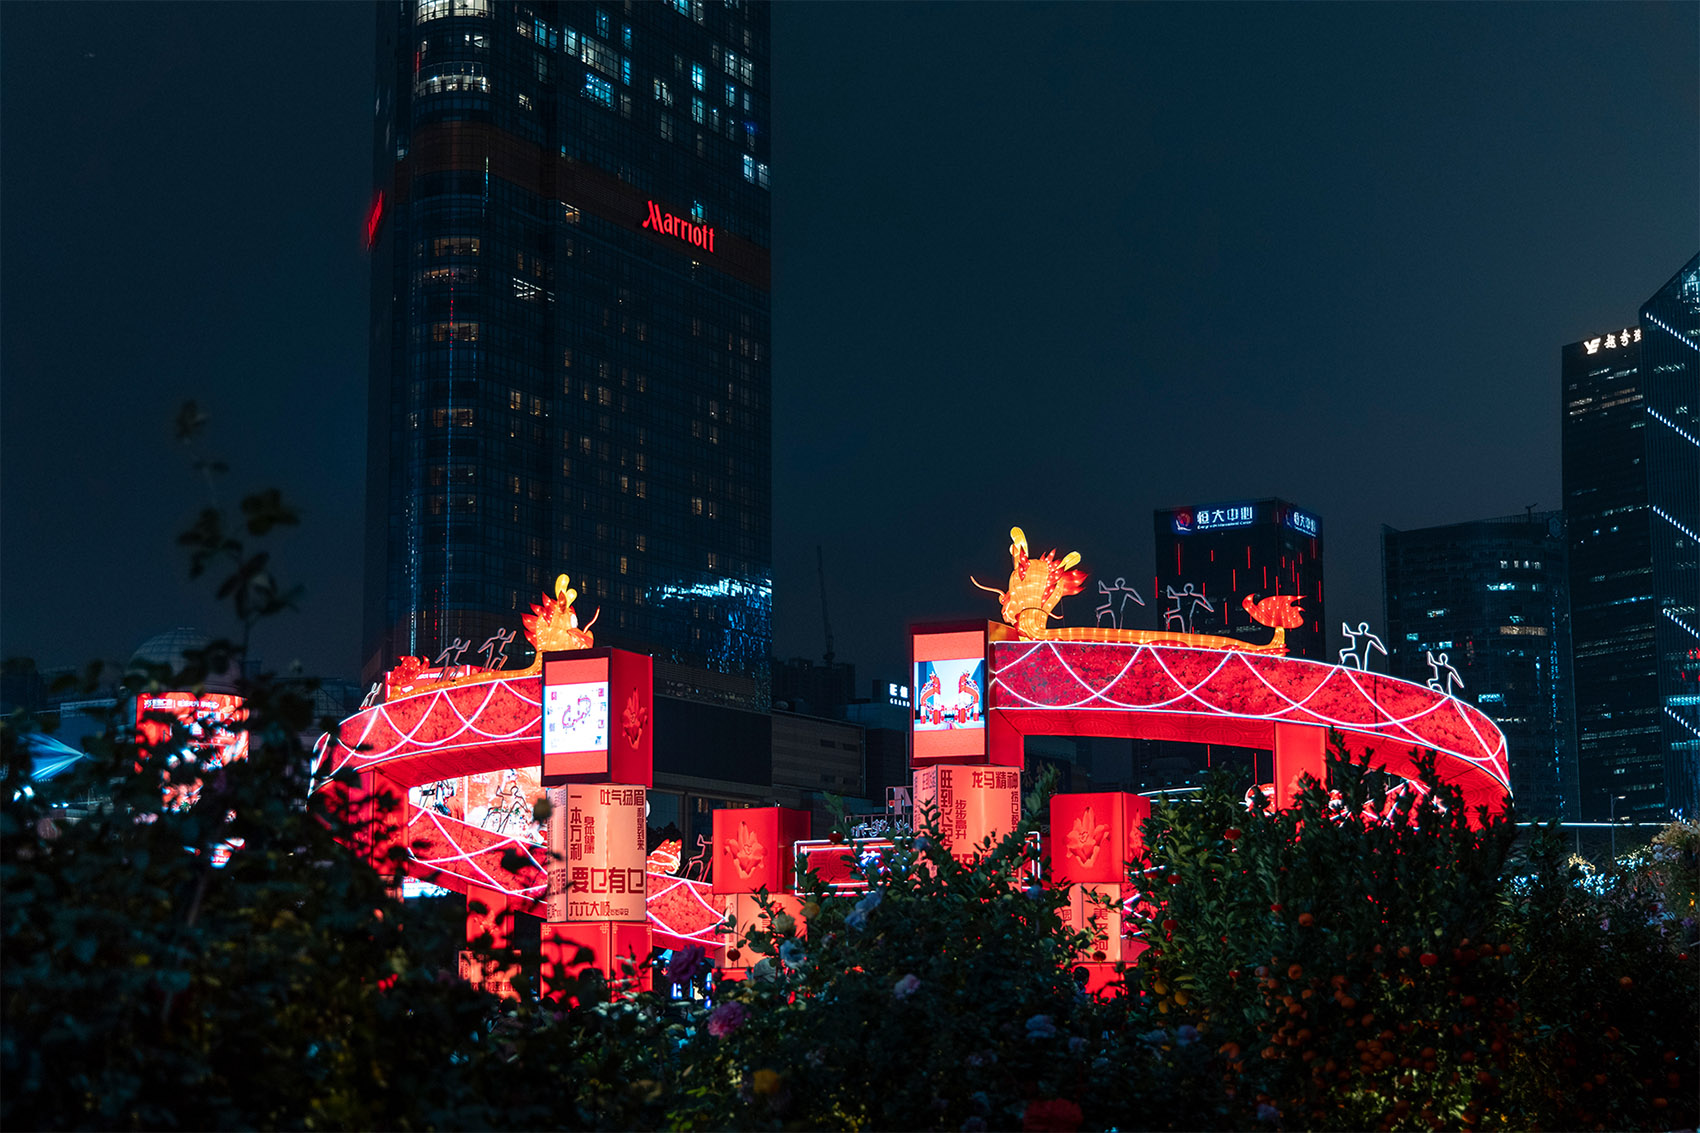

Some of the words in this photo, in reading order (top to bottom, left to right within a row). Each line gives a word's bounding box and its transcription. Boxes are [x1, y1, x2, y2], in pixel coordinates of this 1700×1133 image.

[642, 200, 715, 253] Marriott
[1196, 506, 1253, 525] 恒大中心
[972, 770, 1019, 790] 龙马精神
[600, 789, 645, 806] 吐气扬眉
[940, 769, 953, 847] 旺到飞起
[570, 795, 582, 861] 一本万利
[584, 816, 595, 854] 身体健康
[955, 799, 967, 839] 步步高升
[572, 867, 645, 894] 要乜有乜
[569, 901, 610, 917] 六六大顺
